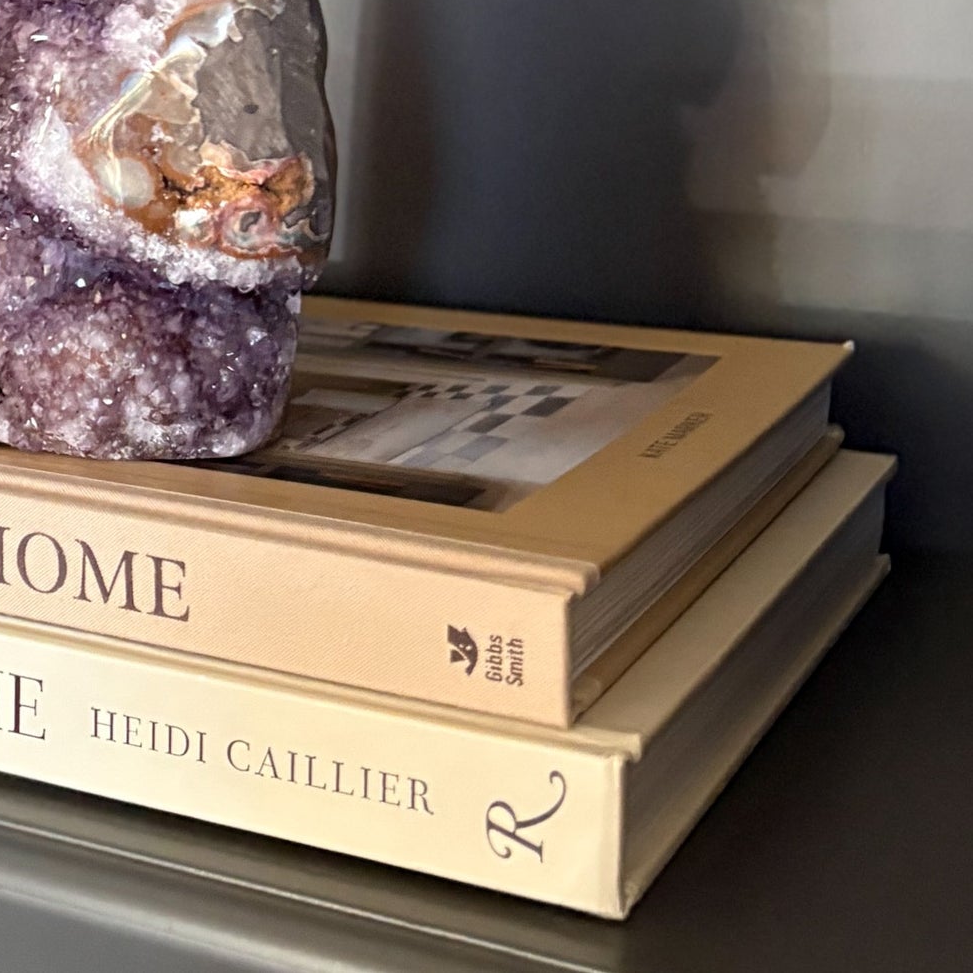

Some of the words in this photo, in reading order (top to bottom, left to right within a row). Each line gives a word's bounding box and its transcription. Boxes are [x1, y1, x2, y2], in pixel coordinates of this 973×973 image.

[485, 634, 503, 683] Gibbs
[505, 638, 524, 687] Smith
[90, 706, 207, 763] HEIDI
[226, 739, 435, 815] CAILLIER
